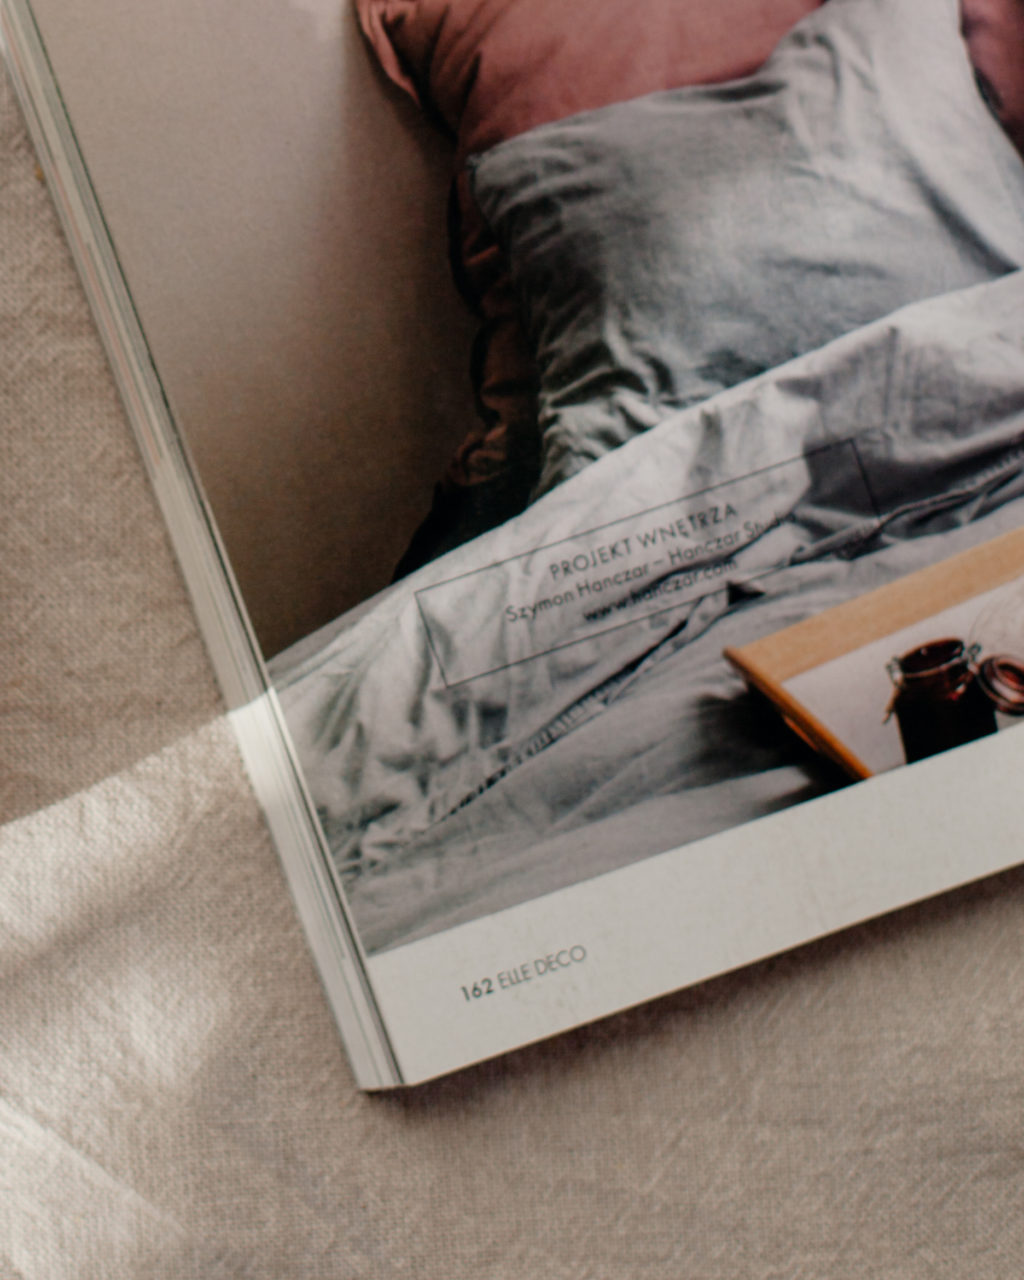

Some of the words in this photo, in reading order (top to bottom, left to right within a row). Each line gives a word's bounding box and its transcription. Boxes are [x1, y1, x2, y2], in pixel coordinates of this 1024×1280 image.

[505, 589, 575, 622] Szymon
[576, 562, 651, 598] Hanczar
[668, 530, 741, 567] Hanczar
[549, 537, 632, 582] PROJEKT
[636, 503, 738, 550] WNĘTRZA
[461, 977, 495, 1002] 162
[497, 963, 534, 990] ELLE
[533, 945, 588, 976] DECO
